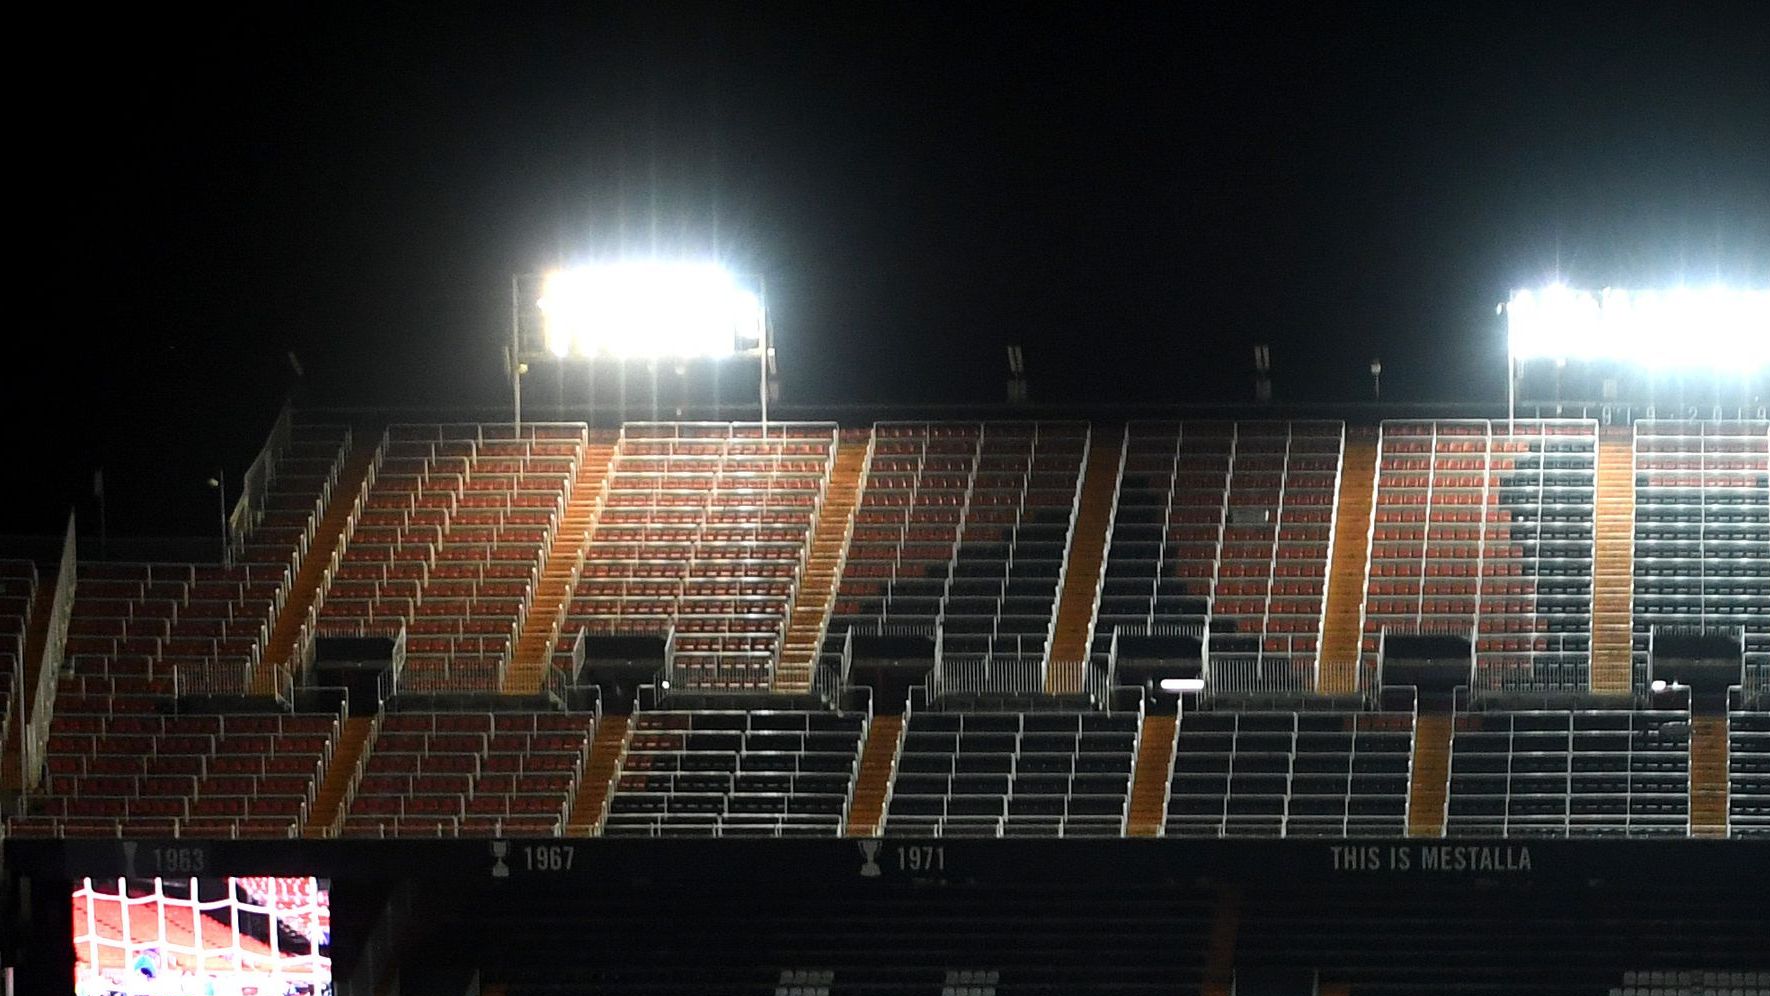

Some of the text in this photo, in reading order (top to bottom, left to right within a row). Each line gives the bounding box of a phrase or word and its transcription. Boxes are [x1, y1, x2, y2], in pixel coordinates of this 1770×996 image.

[154, 847, 205, 872] 1963
[524, 847, 575, 870] 1967
[897, 847, 944, 870] 1971
[1330, 847, 1532, 870] THIS IS MESTALLA
